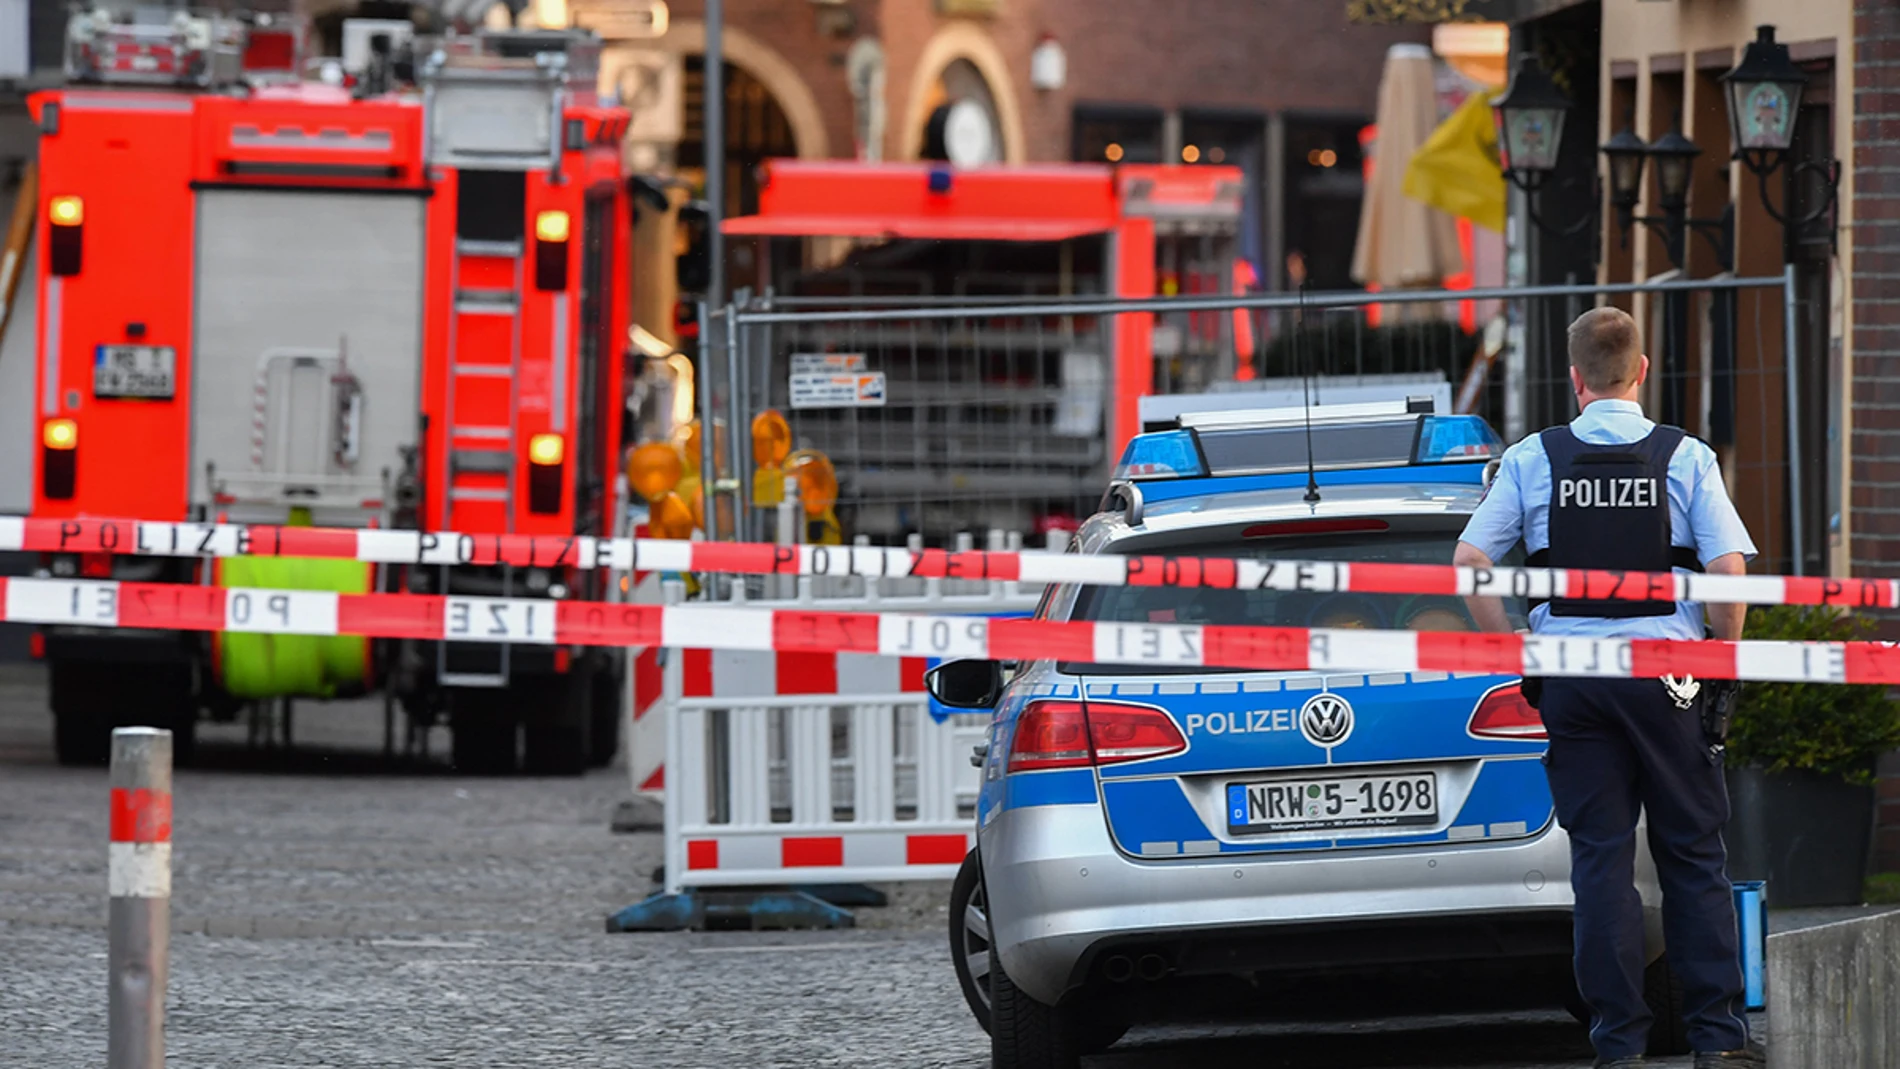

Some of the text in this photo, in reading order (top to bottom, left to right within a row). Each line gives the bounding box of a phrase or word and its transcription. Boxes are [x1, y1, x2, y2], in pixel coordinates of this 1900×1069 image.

[1560, 478, 1657, 507] POLIZEI
[60, 521, 1900, 607] POLIZEI POLIZEI POLIZEI POLIZEI POLIZEI PO
[1187, 709, 1296, 736] POLIZEI
[1308, 701, 1345, 738] VW
[1248, 779, 1431, 819] NRW 5-1698
